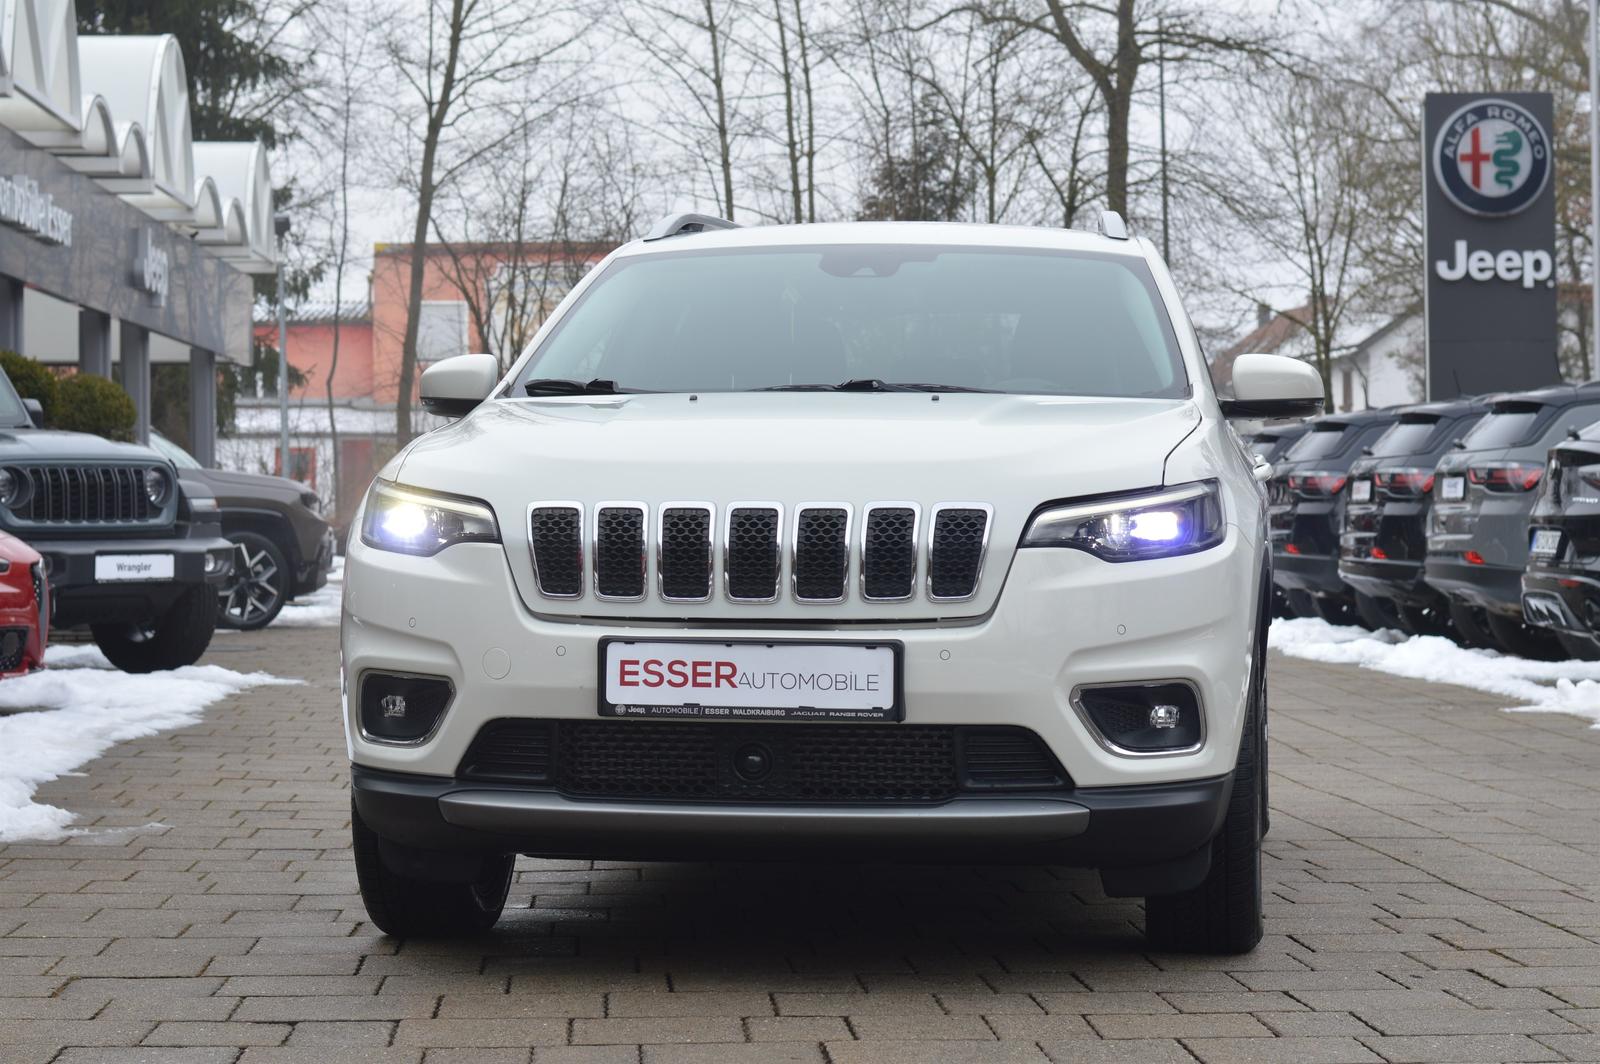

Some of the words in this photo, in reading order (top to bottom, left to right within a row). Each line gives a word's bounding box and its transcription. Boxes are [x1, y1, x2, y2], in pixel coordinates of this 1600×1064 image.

[1444, 112, 1479, 159] ALFA
[1486, 105, 1545, 160] ROMEO
[1435, 239, 1553, 288] Jeep
[116, 562, 152, 573] Wrangler
[628, 706, 646, 714] Jeep
[651, 707, 699, 715] AUTOMOBILE
[732, 708, 786, 717] WALDKRAIBURG
